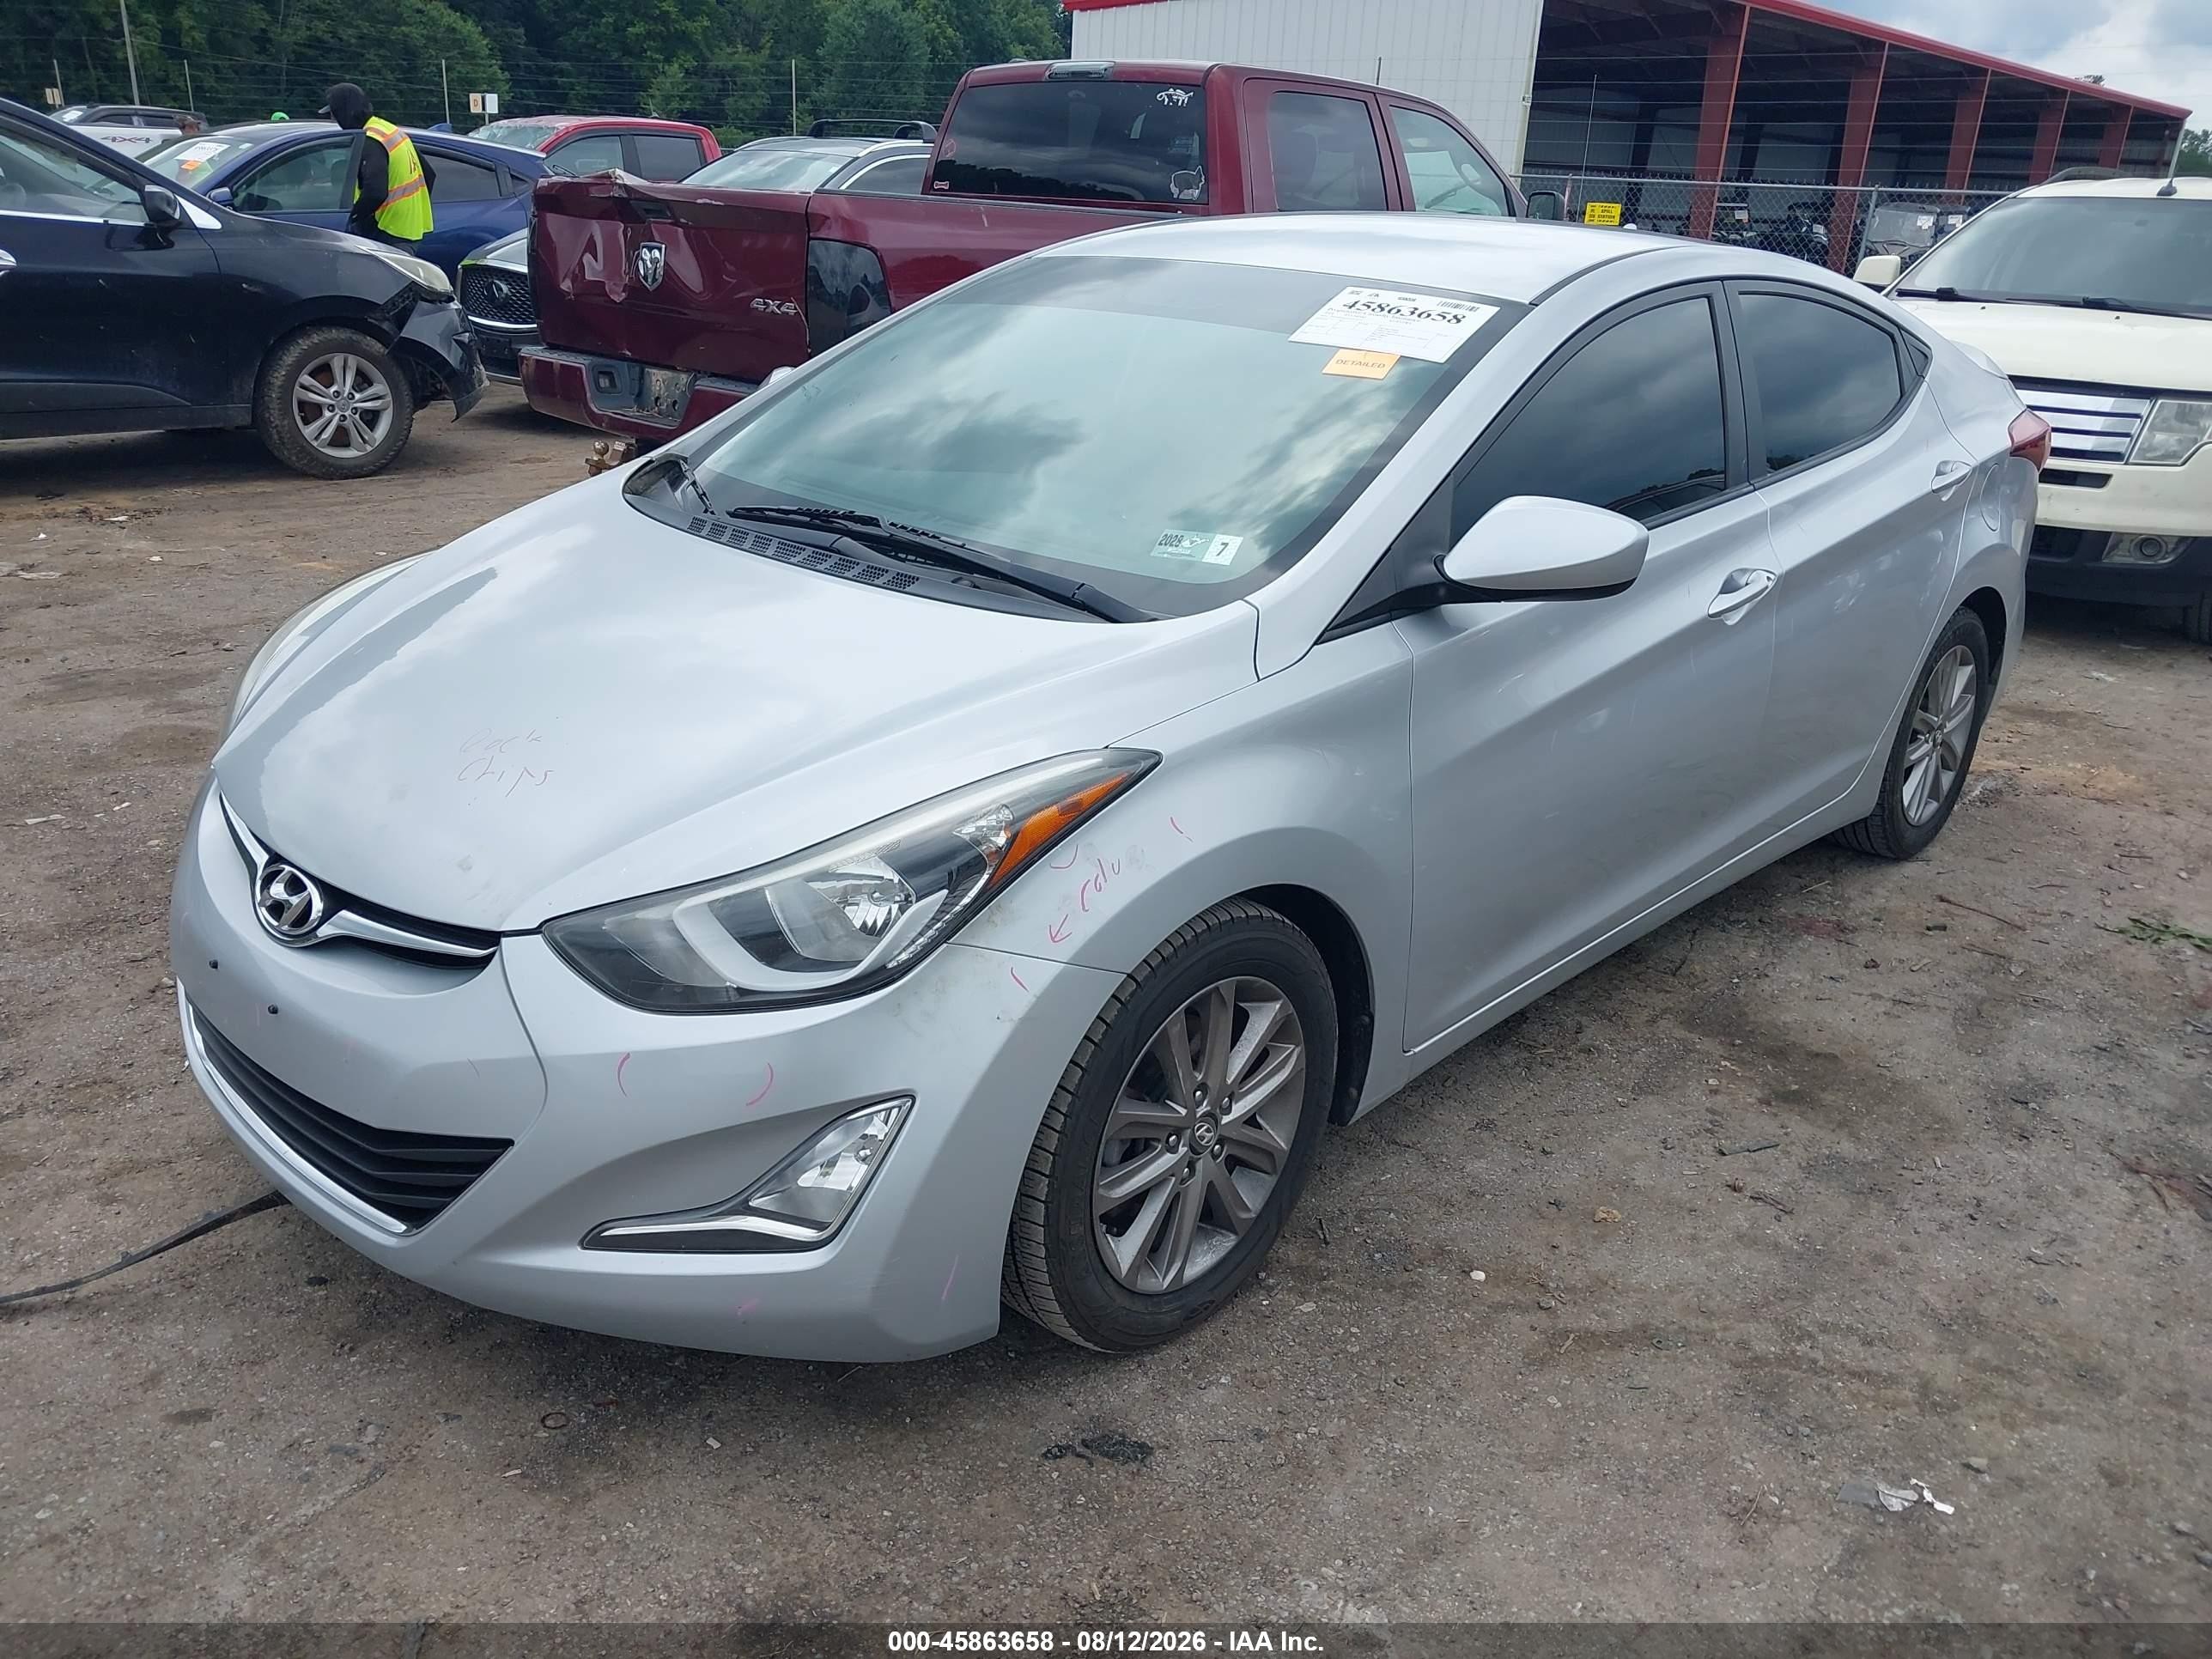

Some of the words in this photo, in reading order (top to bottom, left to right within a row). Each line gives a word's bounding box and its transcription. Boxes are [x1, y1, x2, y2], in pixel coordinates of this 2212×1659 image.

[1342, 300, 1467, 325] 45863658
[1335, 358, 1386, 369] DETAILED
[1215, 542, 1229, 556] 7
